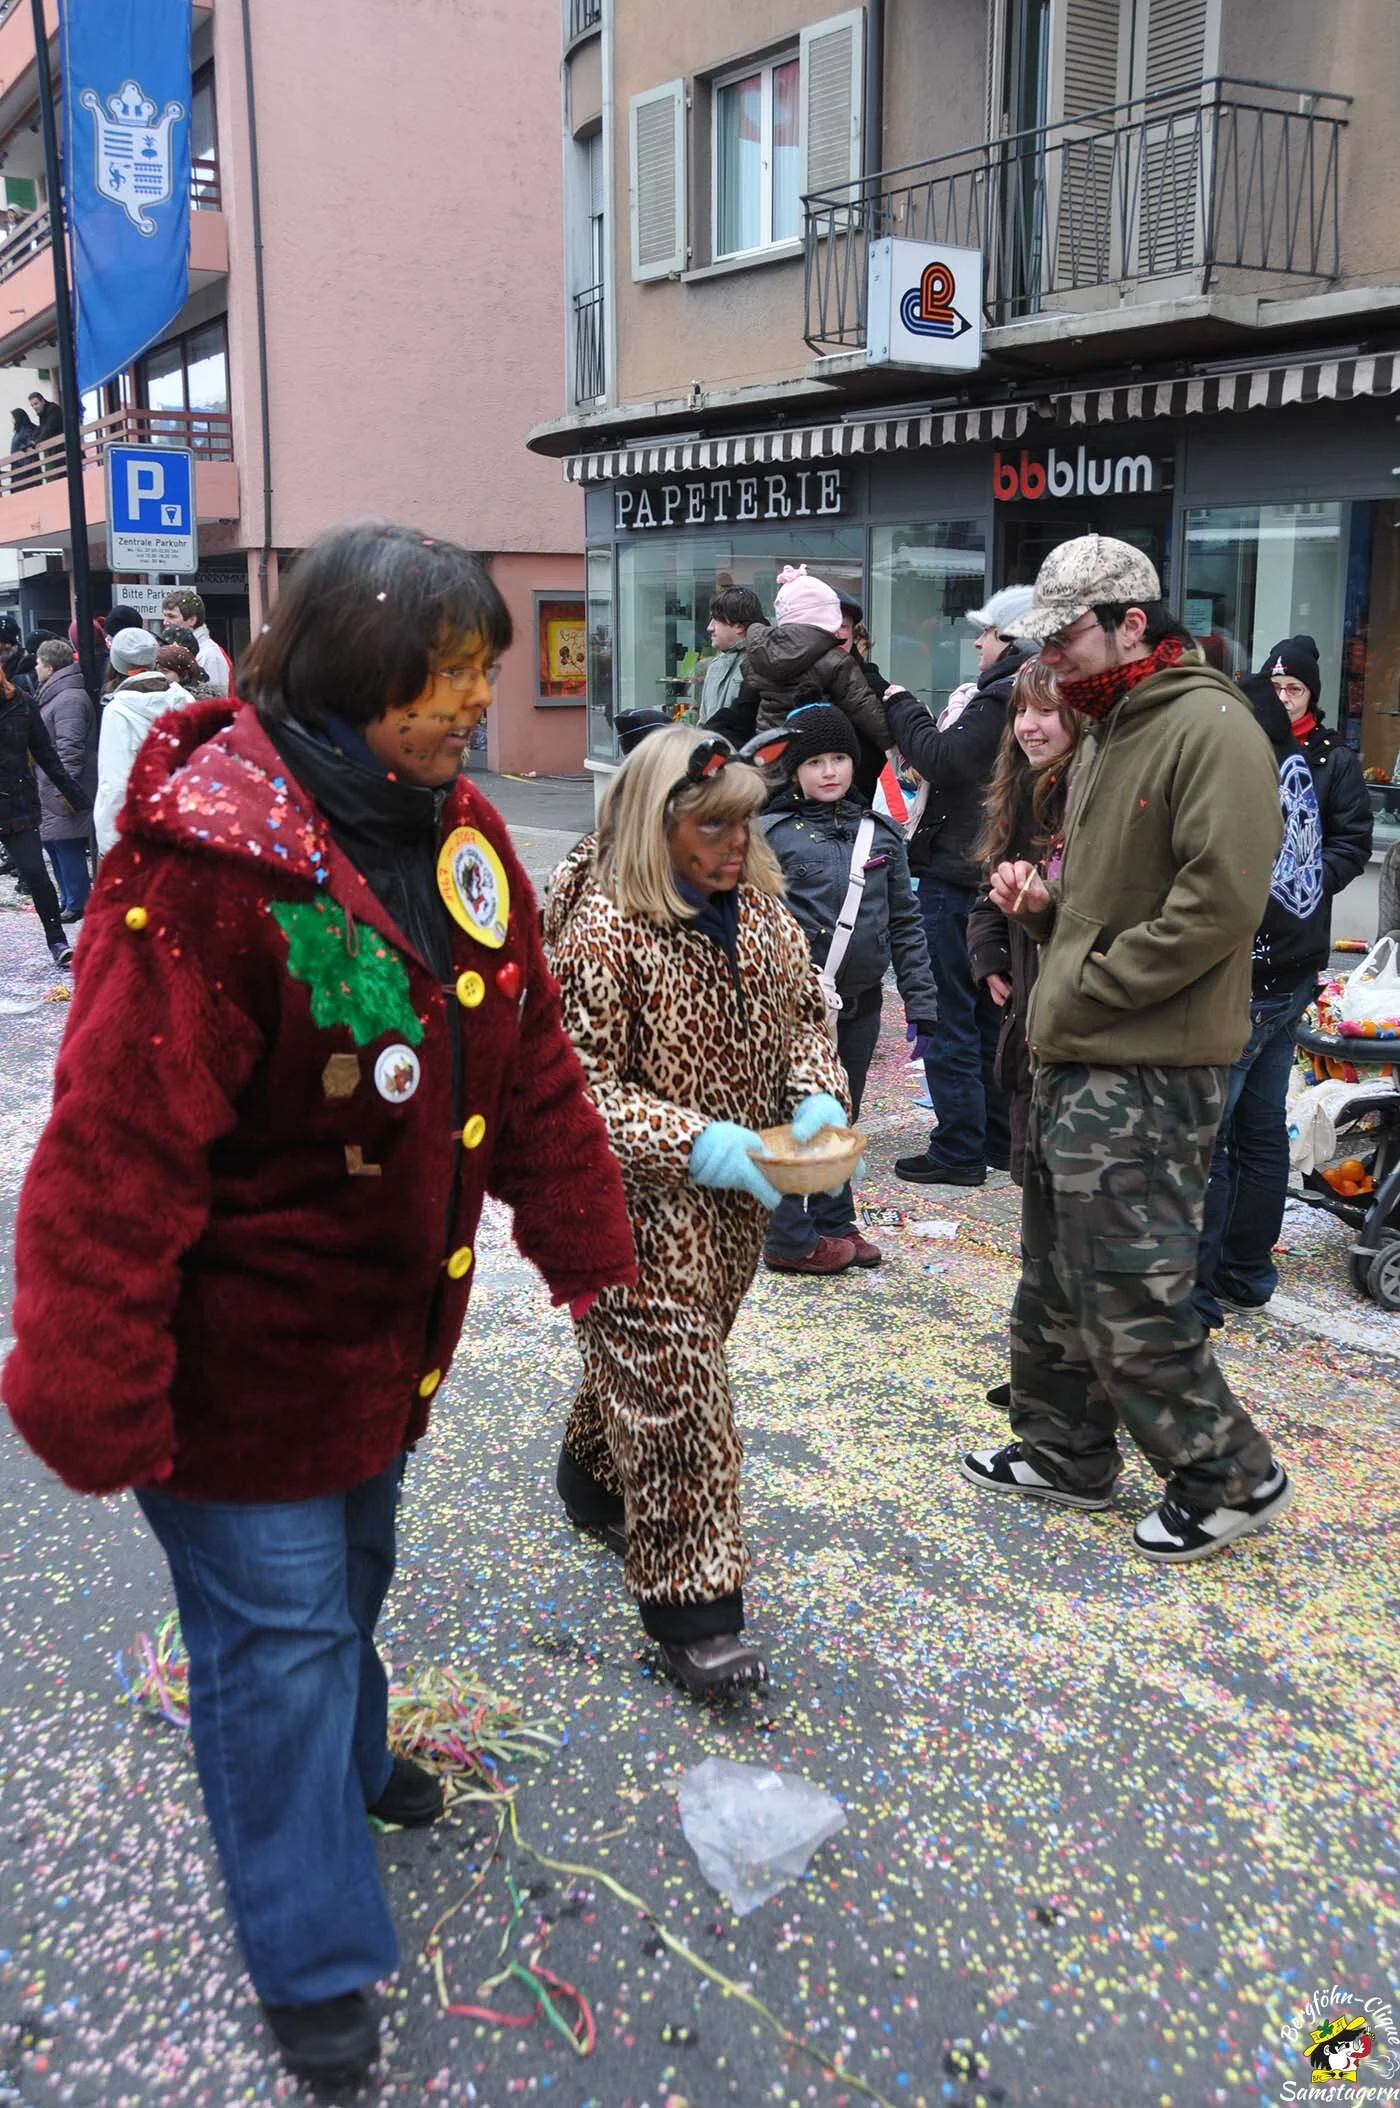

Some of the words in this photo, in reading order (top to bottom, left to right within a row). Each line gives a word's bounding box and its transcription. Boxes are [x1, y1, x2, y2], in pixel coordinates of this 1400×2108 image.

[127, 460, 165, 521] P
[615, 469, 841, 529] PAPETERIE
[118, 537, 152, 547] Zentrale
[155, 539, 187, 548] Parkuhr
[122, 588, 143, 599] Bitte
